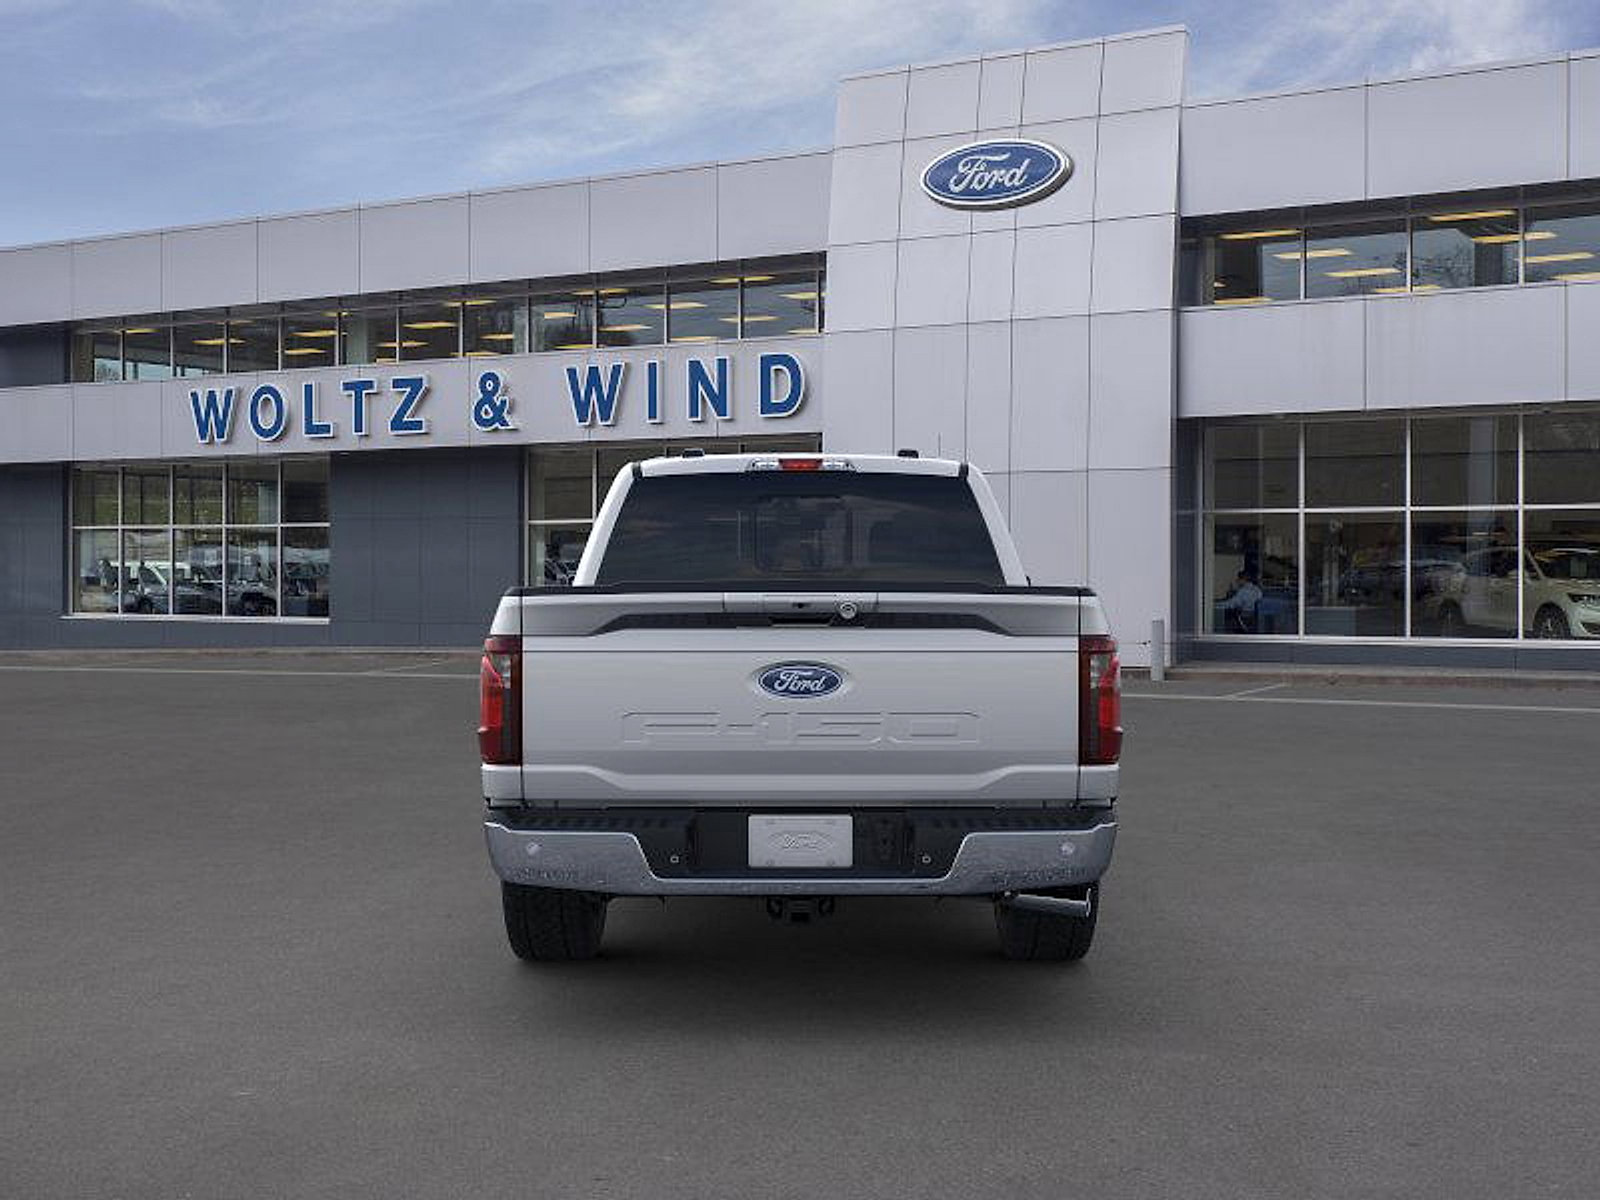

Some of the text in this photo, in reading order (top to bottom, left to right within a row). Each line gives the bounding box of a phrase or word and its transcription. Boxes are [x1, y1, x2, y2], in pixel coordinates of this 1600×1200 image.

[949, 151, 1031, 194] Ford
[189, 352, 806, 444] WOLTZ & WIND
[773, 669, 827, 692] Ford
[621, 710, 981, 747] F-150
